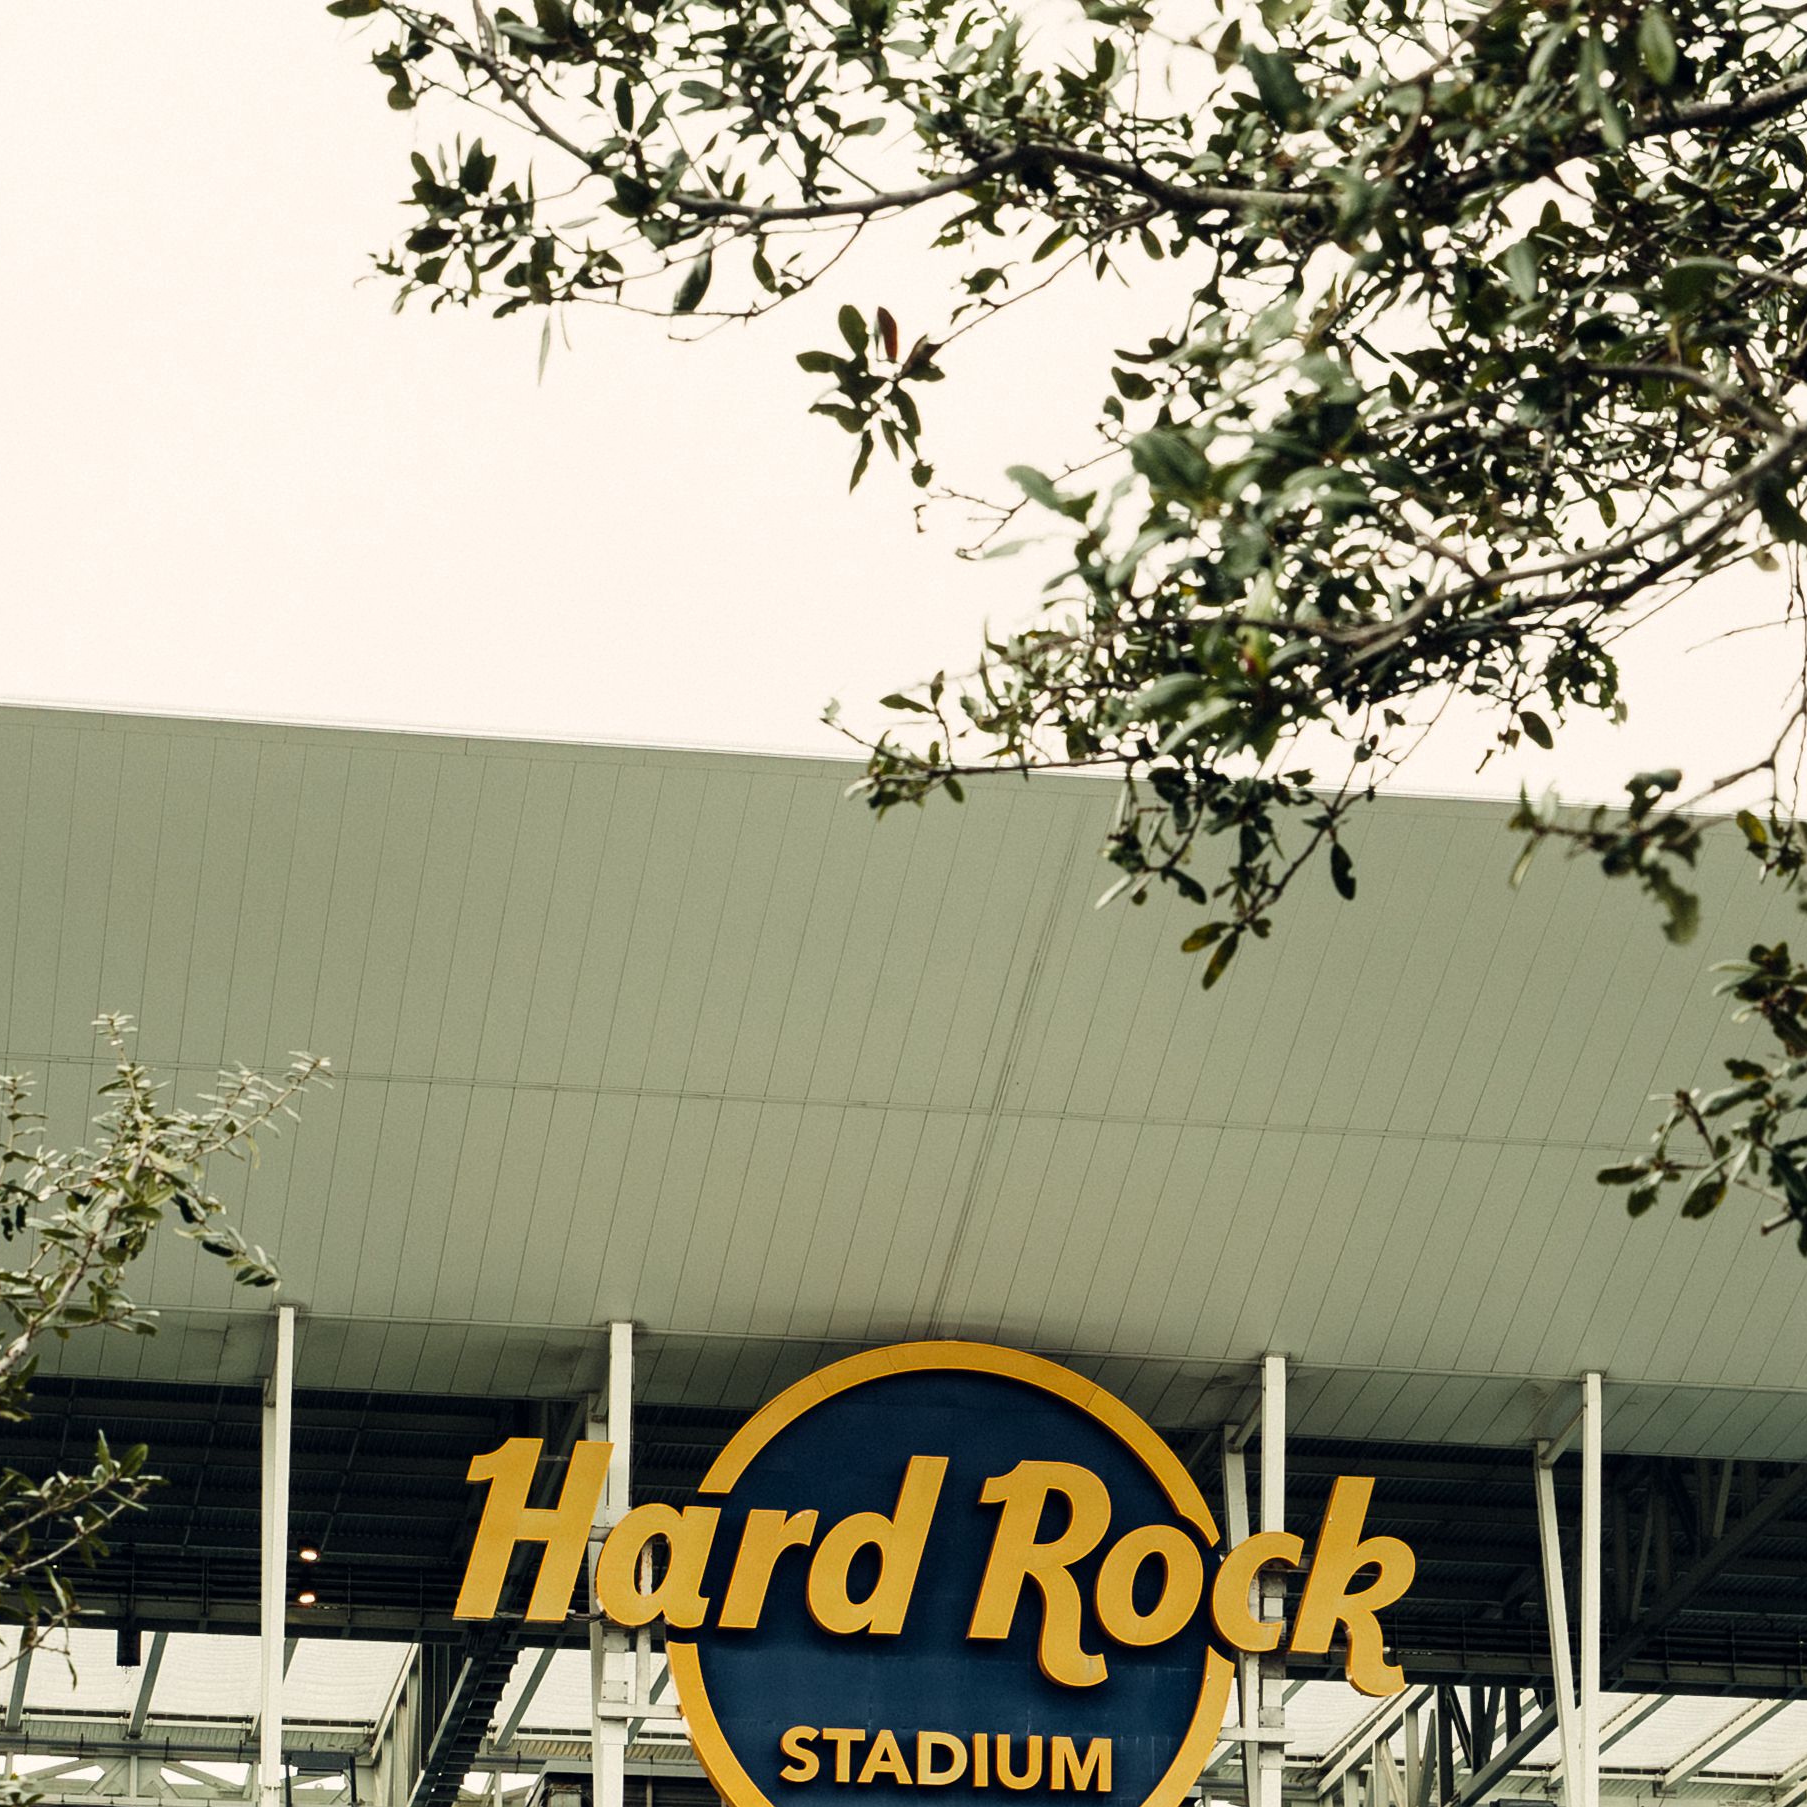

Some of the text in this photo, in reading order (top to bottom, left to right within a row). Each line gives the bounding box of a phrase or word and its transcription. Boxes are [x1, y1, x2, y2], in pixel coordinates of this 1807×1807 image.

[452, 1437, 1416, 1697] Hard Rock
[779, 1725, 1112, 1793] STADIUM
